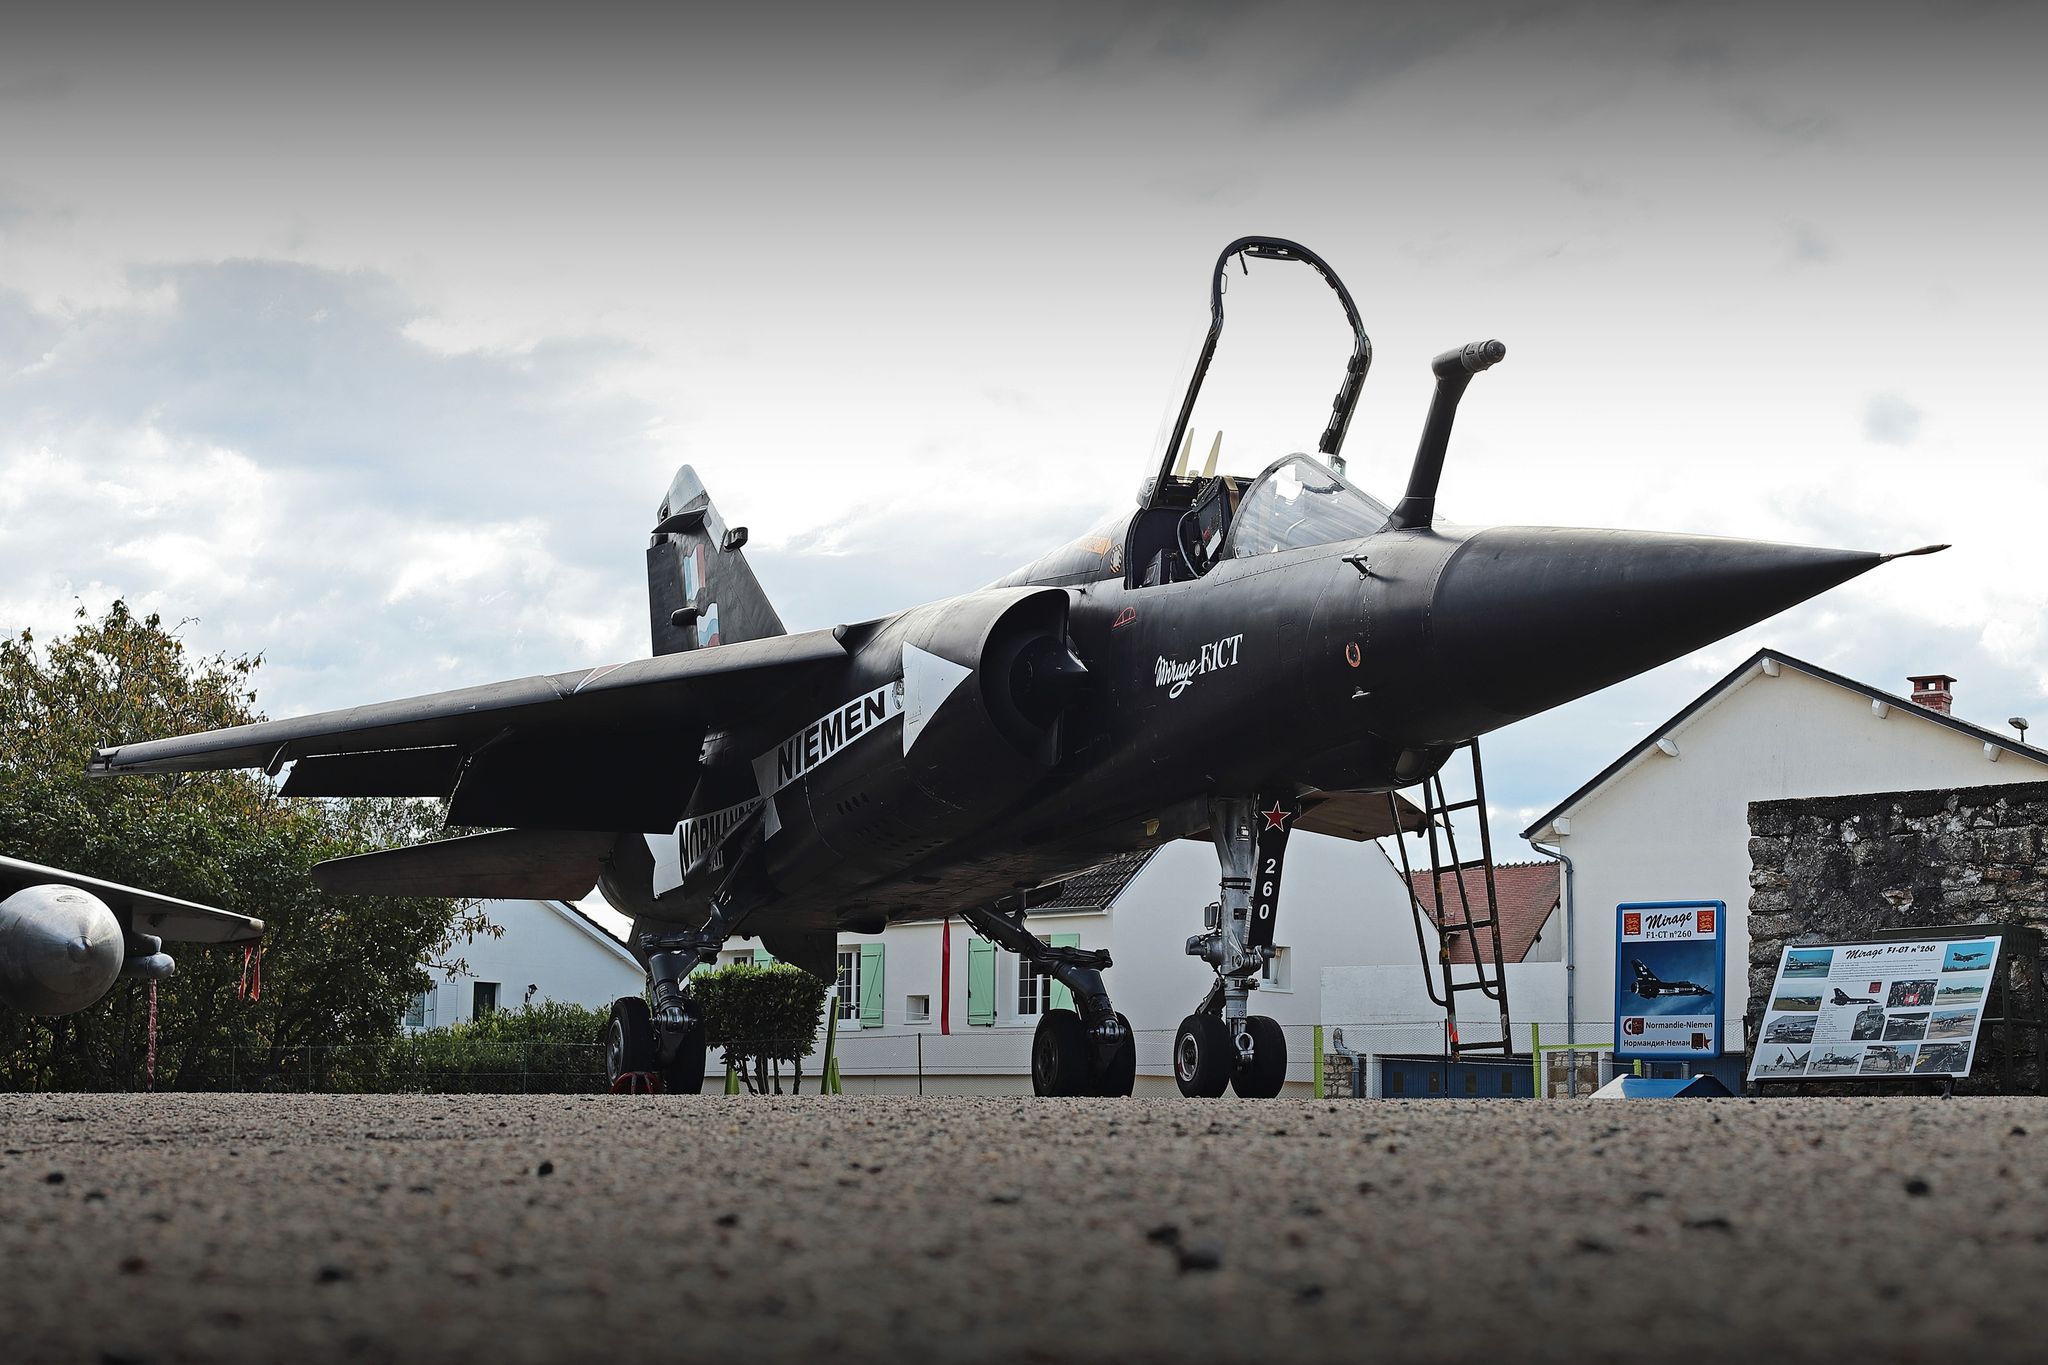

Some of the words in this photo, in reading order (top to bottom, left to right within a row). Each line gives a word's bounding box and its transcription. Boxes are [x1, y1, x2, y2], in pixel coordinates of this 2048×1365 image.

[1154, 655, 1202, 699] Mirage
[1198, 633, 1244, 675] F1CT
[777, 691, 886, 788] NIEMEN
[679, 801, 757, 877] NORMANDI
[1258, 858, 1277, 920] 260
[1645, 911, 1693, 930] Mirage
[1846, 949, 1882, 959] Mirage
[1623, 1039, 1691, 1048] Нормандия-Неман
[1646, 1021, 1713, 1029] Normandie-Niemen
